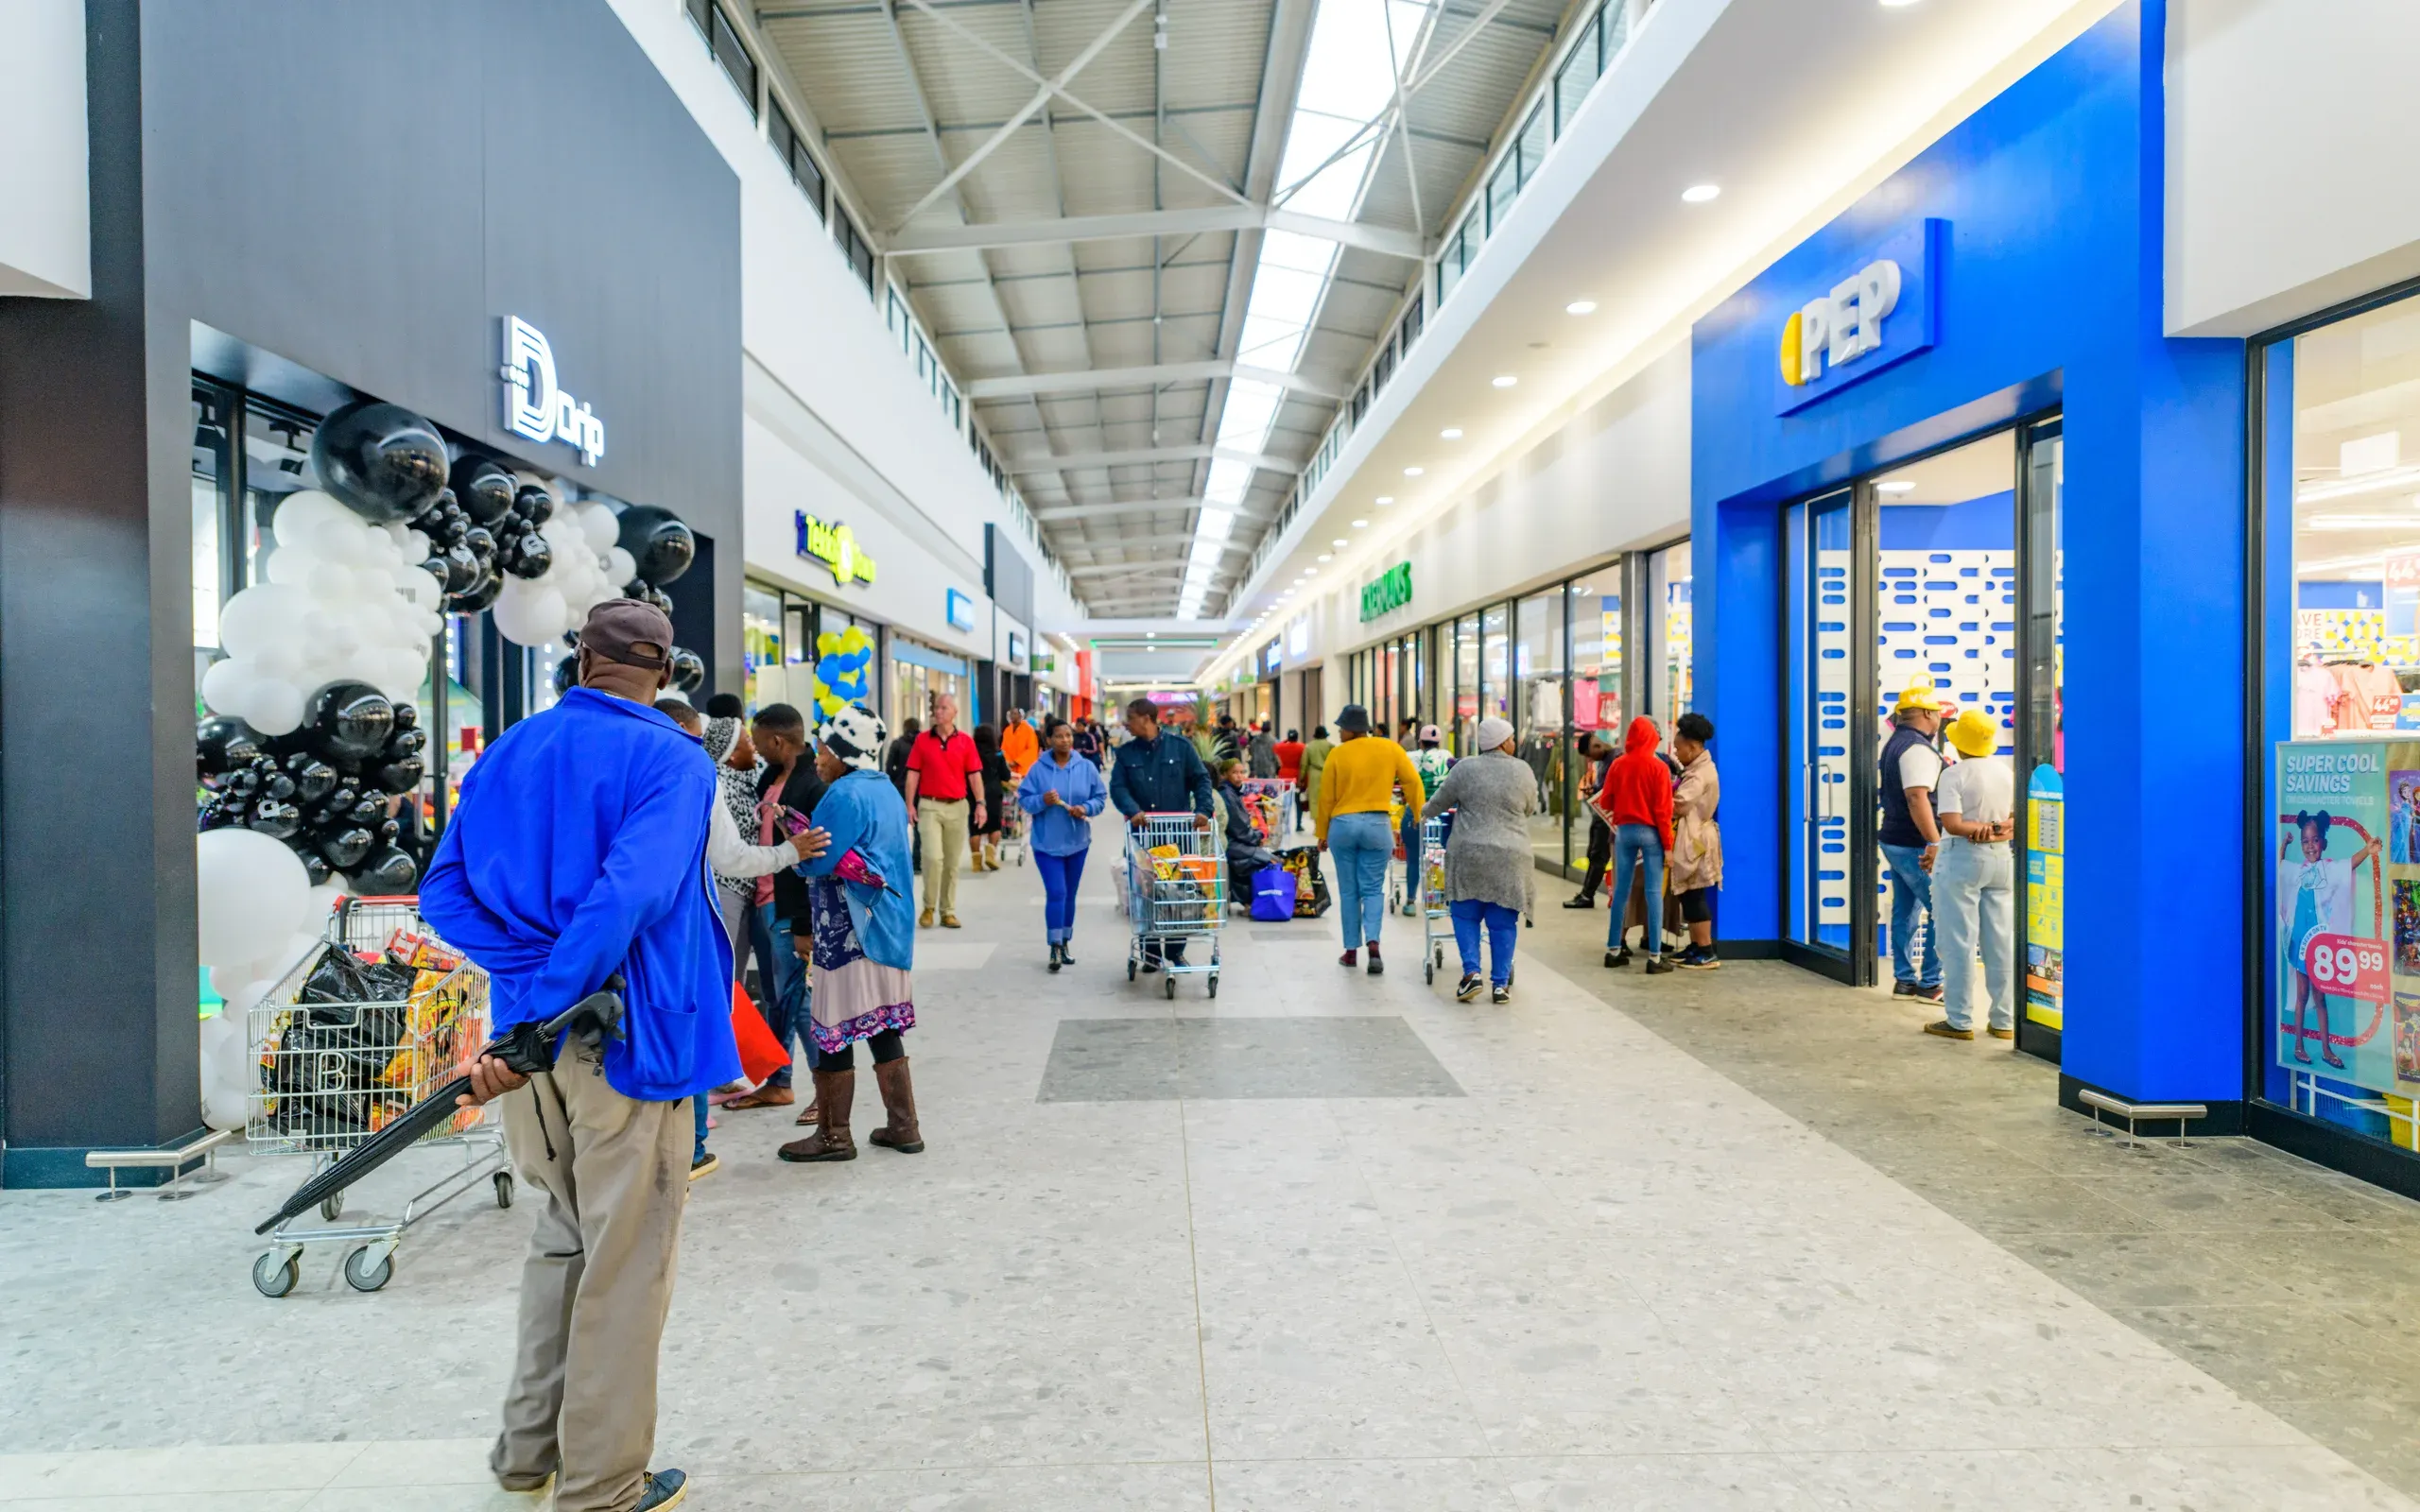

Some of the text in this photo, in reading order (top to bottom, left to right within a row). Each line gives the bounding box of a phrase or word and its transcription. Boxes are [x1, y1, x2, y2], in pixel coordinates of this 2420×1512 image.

[1801, 259, 1901, 382] PEP
[2286, 753, 2380, 774] SUPER COOL
[2285, 775, 2351, 794] SAVINGS
